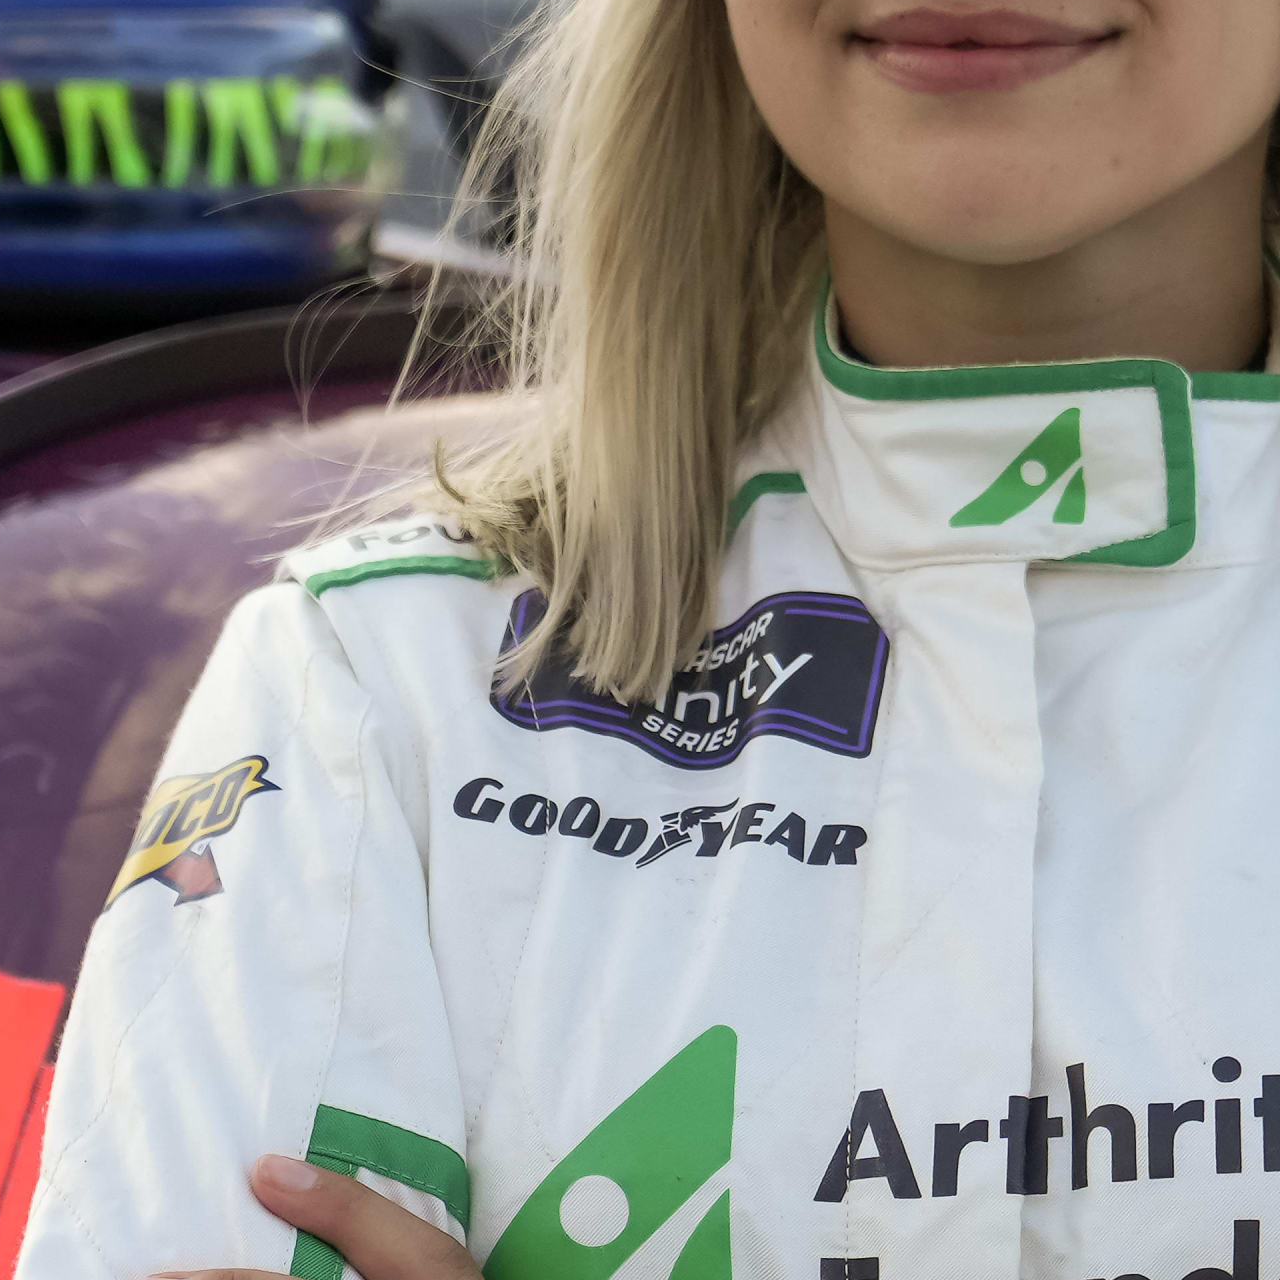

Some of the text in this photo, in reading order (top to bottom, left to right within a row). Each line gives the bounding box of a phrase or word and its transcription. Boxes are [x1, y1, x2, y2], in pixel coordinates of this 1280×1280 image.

[684, 611, 774, 673] ASCAR
[641, 714, 740, 753] SERIES
[453, 777, 868, 867] GOODYEAR
